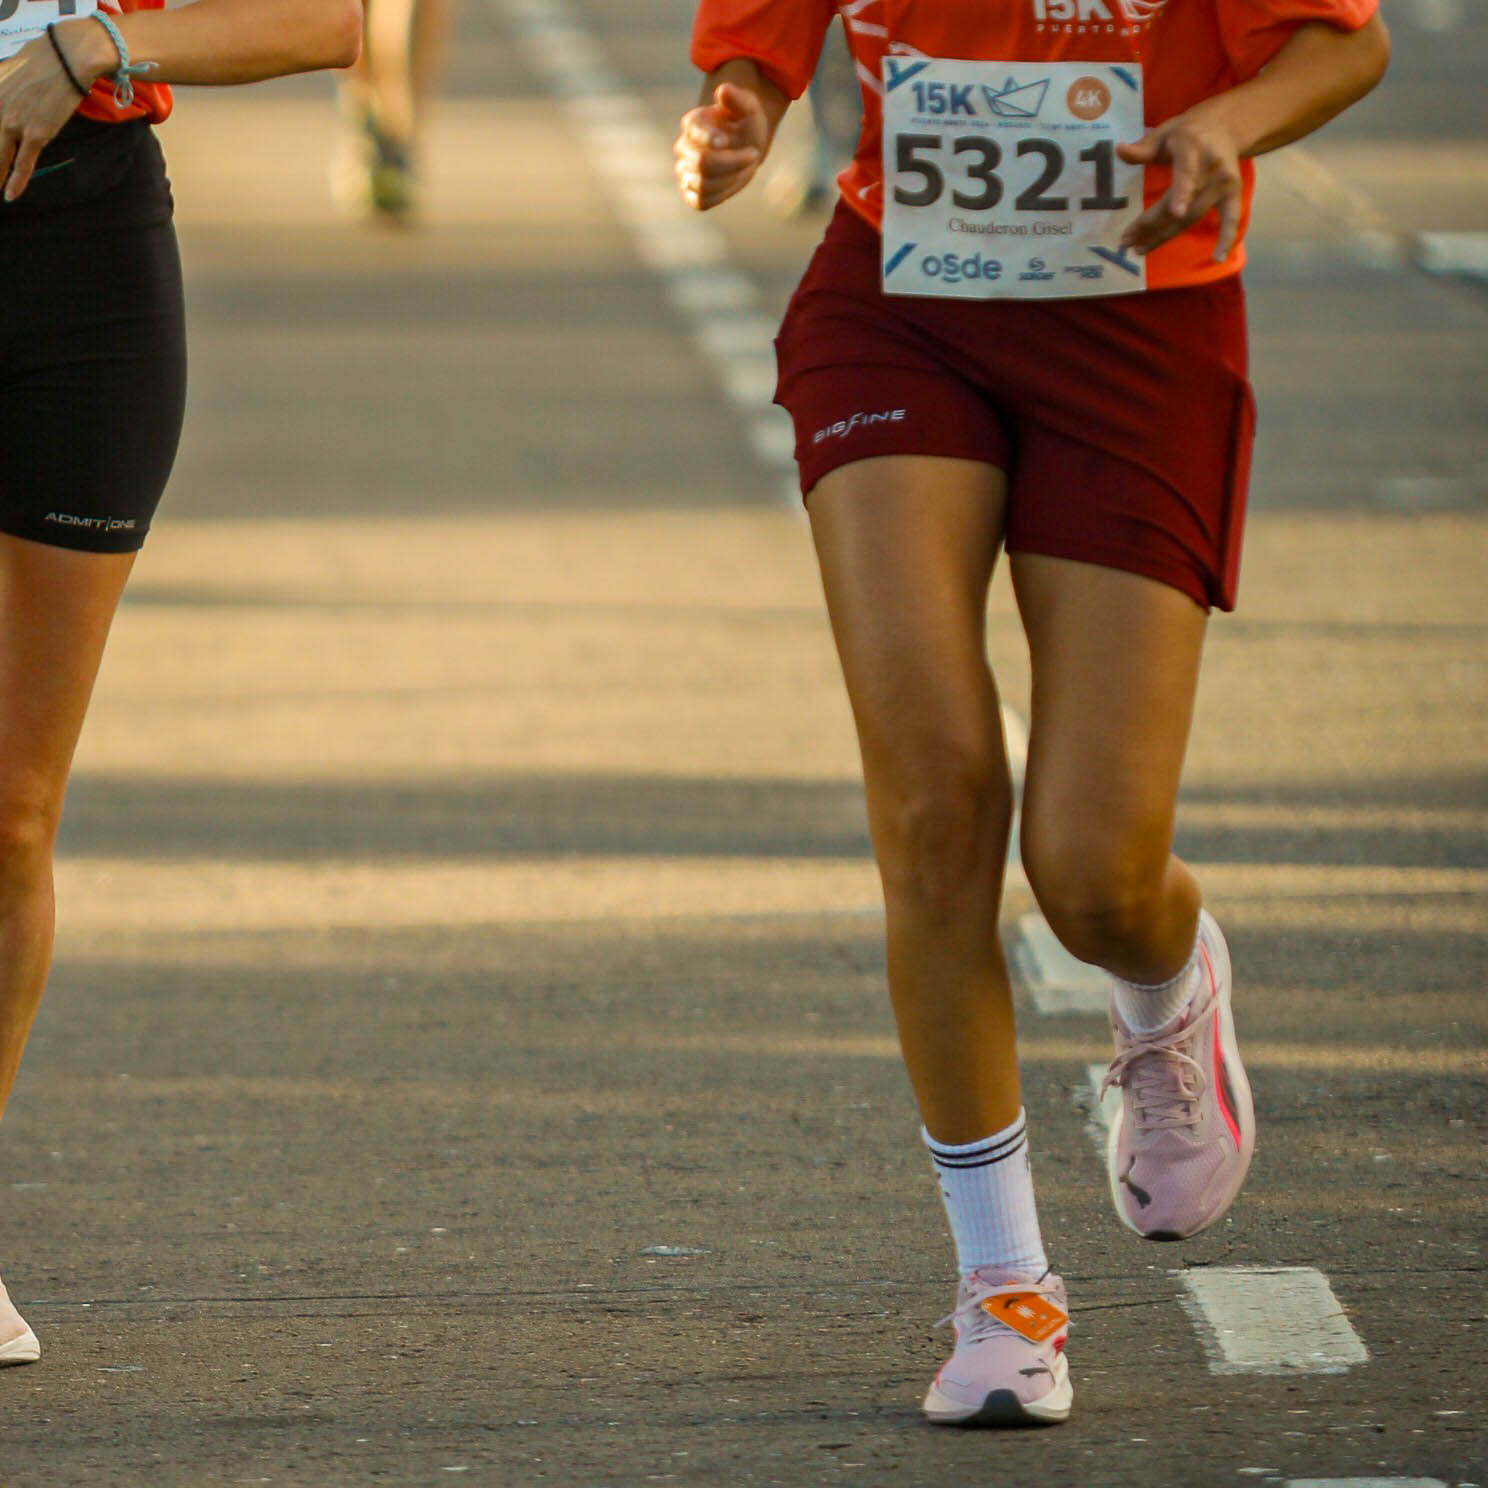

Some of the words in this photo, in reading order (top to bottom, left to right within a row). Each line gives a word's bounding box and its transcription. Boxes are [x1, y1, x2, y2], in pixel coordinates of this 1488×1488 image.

[911, 80, 976, 115] 15K
[1075, 90, 1102, 108] 4K
[894, 133, 1128, 211] 5321
[922, 253, 1002, 283] osde
